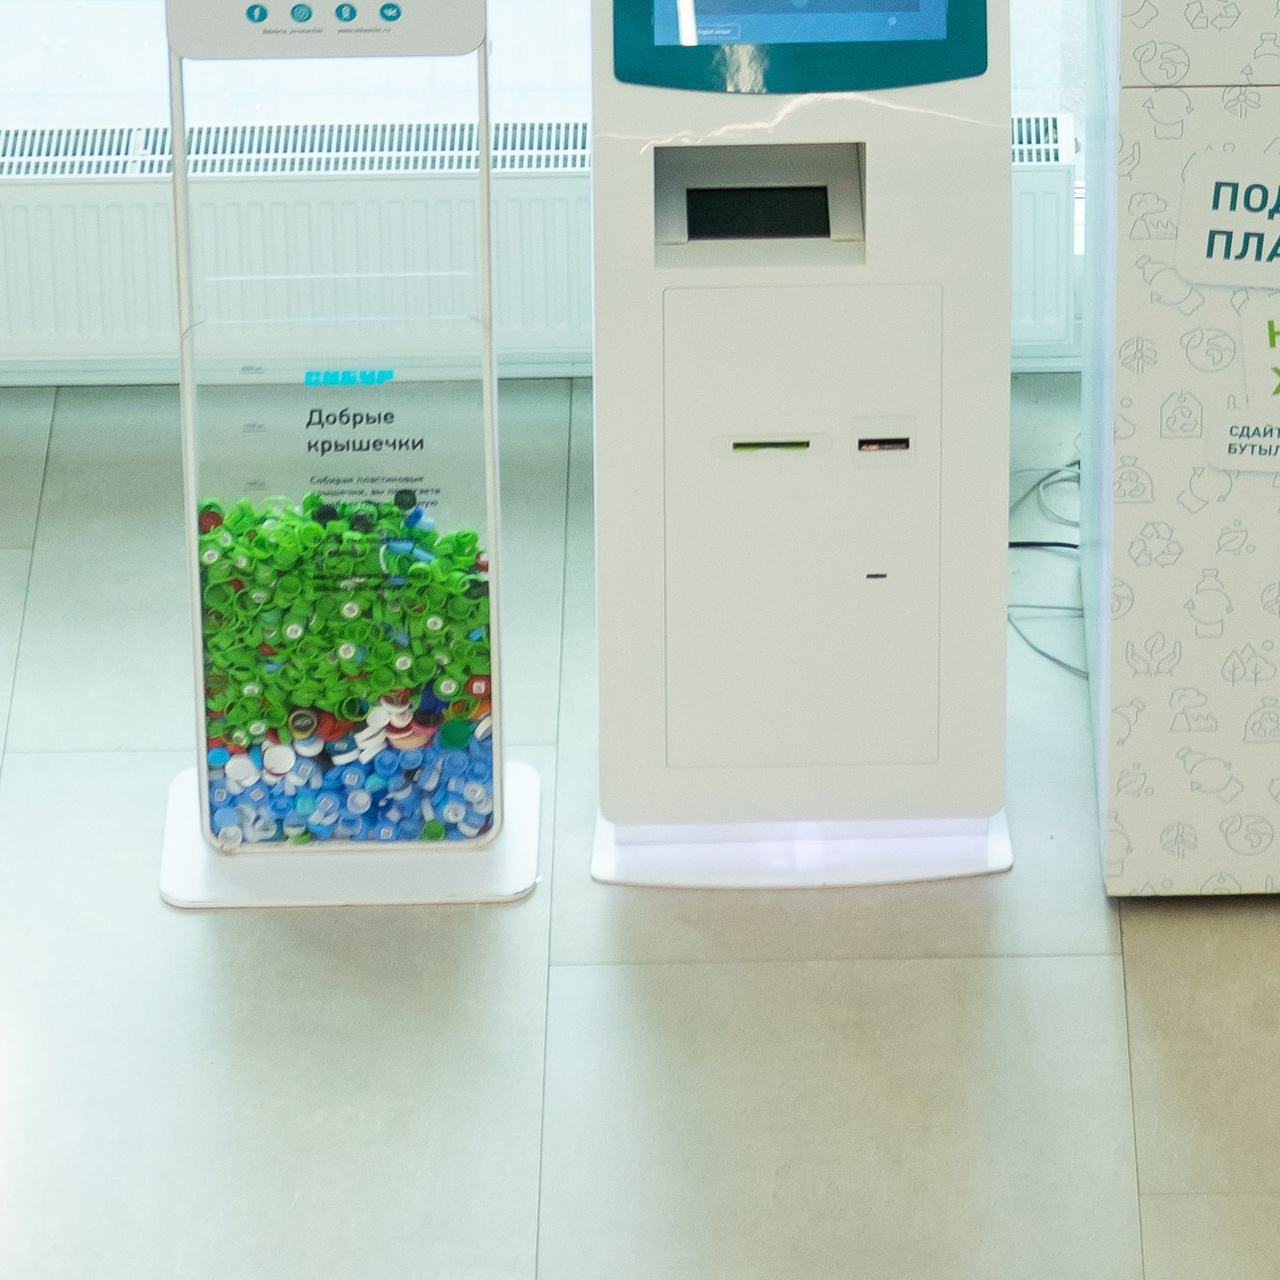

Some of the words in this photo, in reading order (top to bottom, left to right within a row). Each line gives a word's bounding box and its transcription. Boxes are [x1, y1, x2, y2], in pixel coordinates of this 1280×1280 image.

[304, 369, 395, 387] СИБУР
[305, 407, 395, 430] Добрые
[307, 436, 425, 457] крышечки
